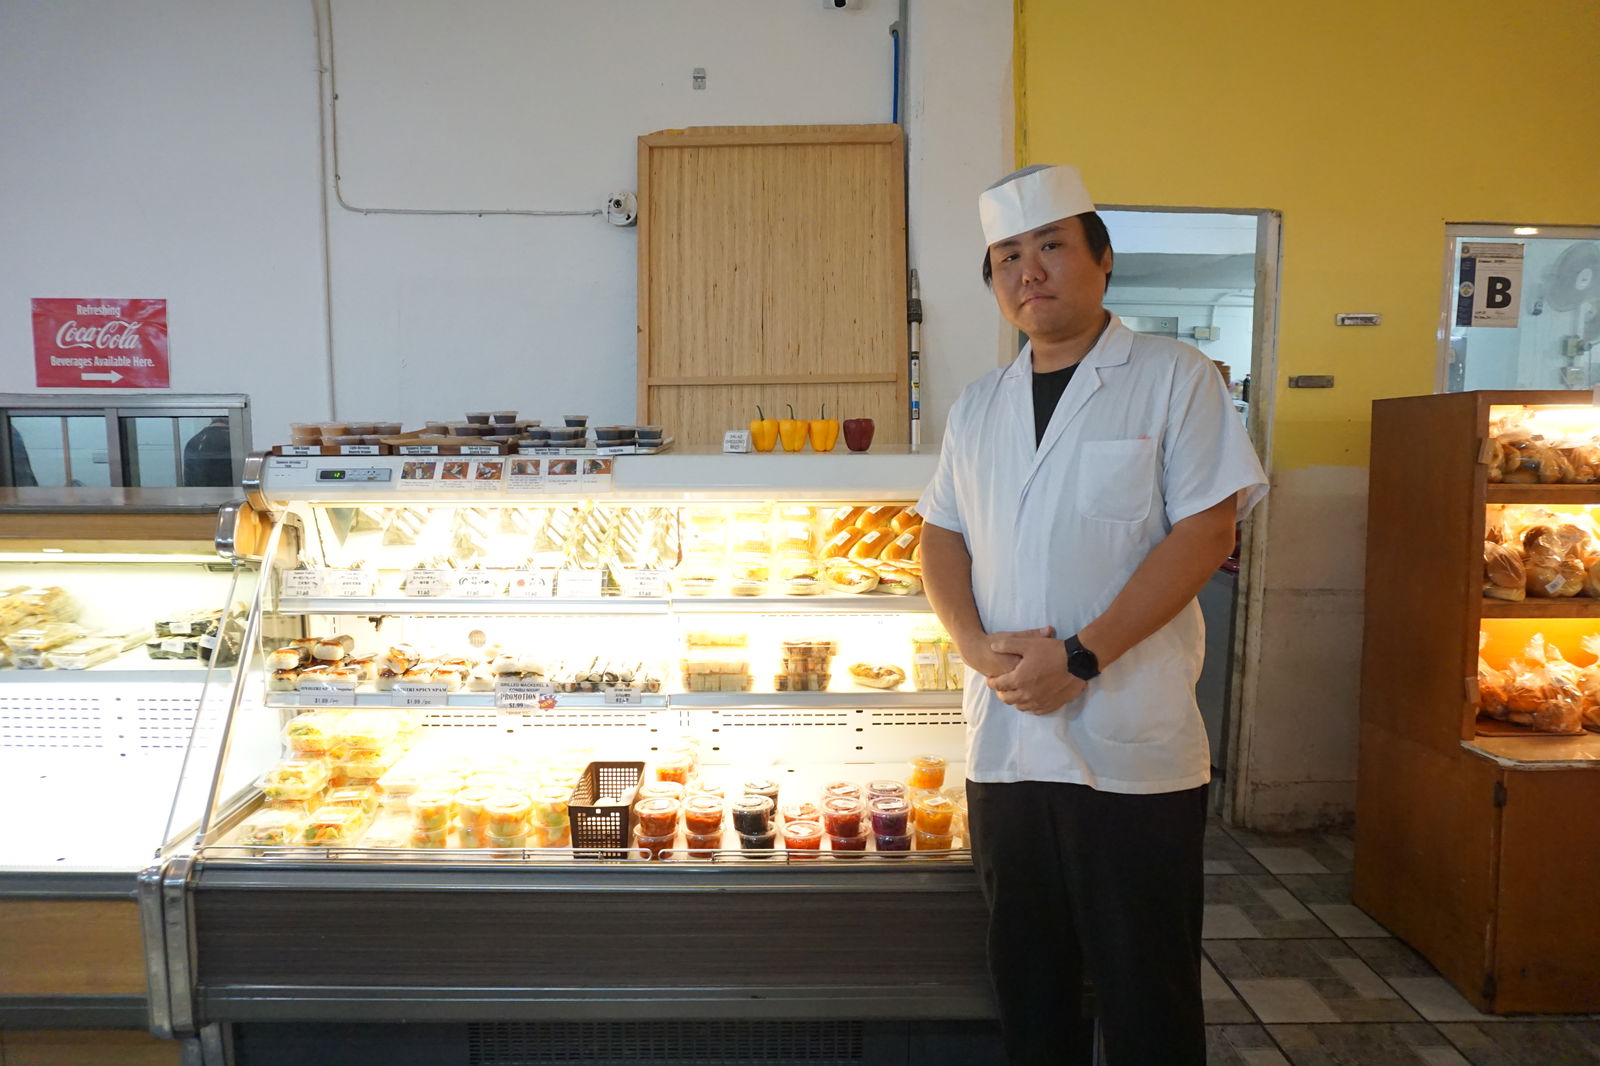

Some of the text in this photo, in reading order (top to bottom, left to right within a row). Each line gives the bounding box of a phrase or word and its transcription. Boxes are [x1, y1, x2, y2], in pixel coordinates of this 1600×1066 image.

[1486, 276, 1512, 309] B
[77, 304, 120, 318] Refreshing
[56, 320, 143, 349] Coca-Cola
[50, 355, 156, 368] Beverages Available Here.
